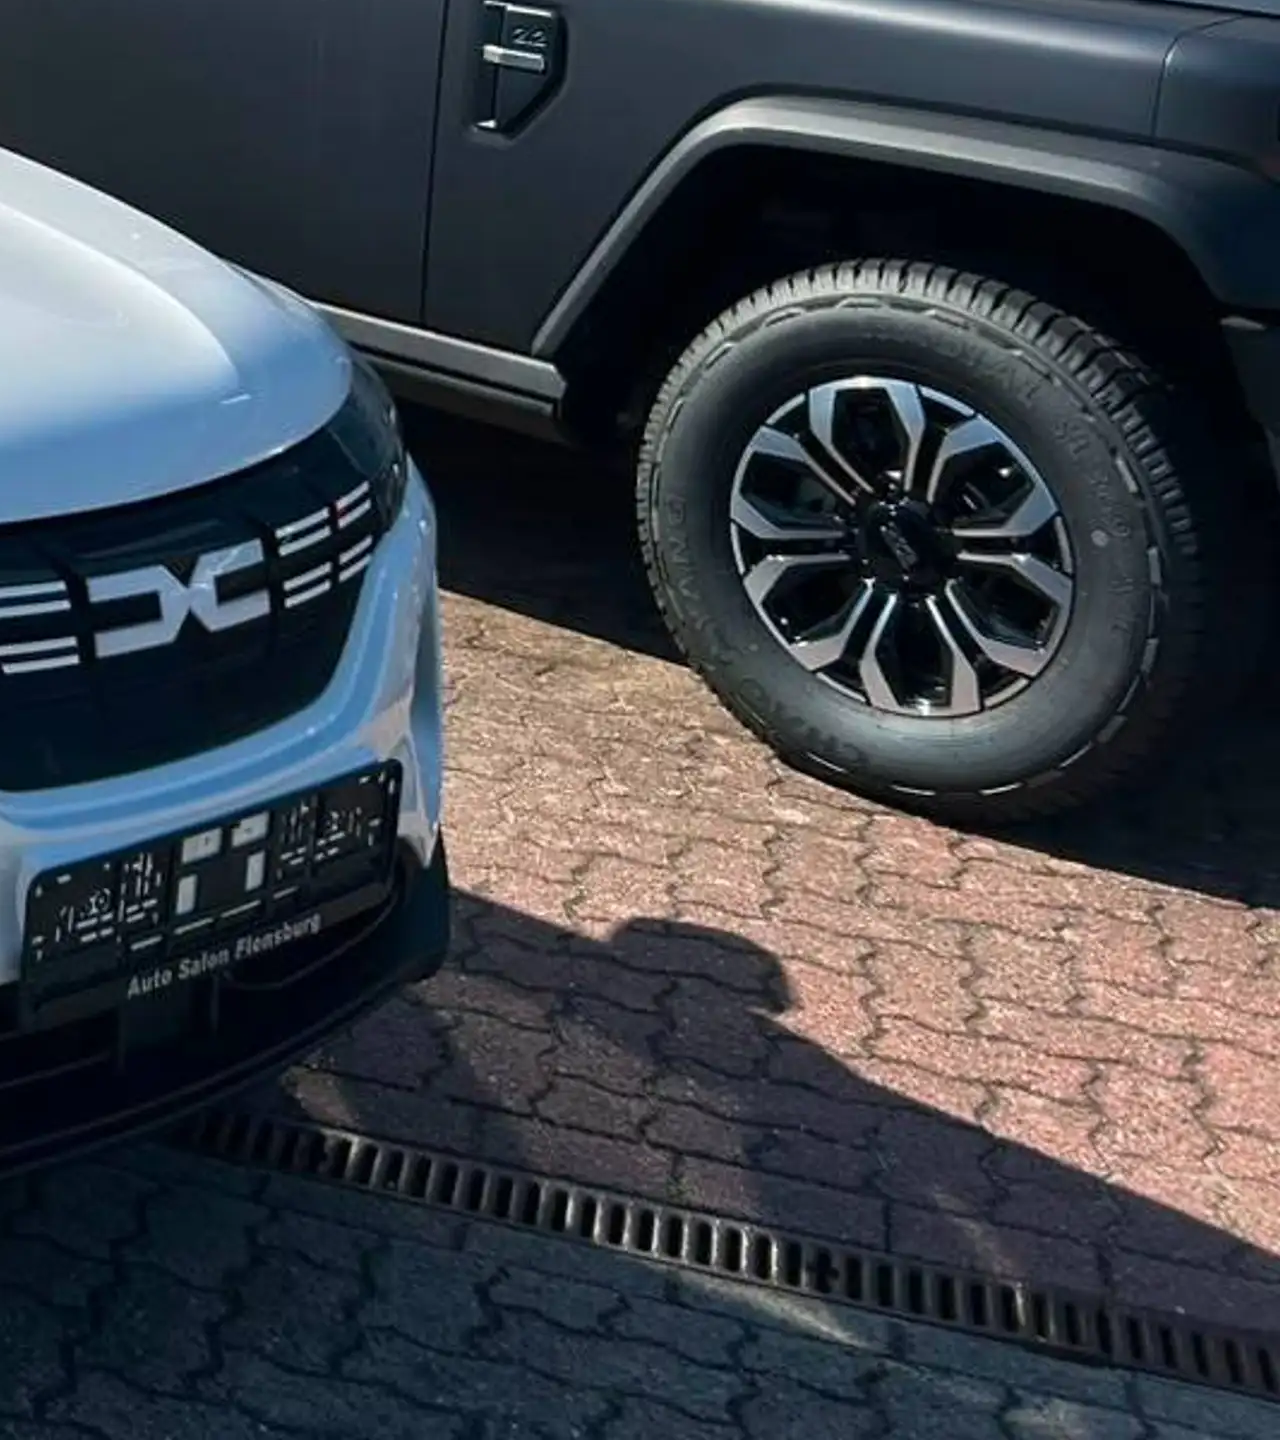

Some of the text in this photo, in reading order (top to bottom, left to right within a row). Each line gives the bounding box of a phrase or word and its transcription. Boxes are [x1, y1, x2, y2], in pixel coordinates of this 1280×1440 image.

[128, 912, 322, 1000] Auto Salon Flensburg
